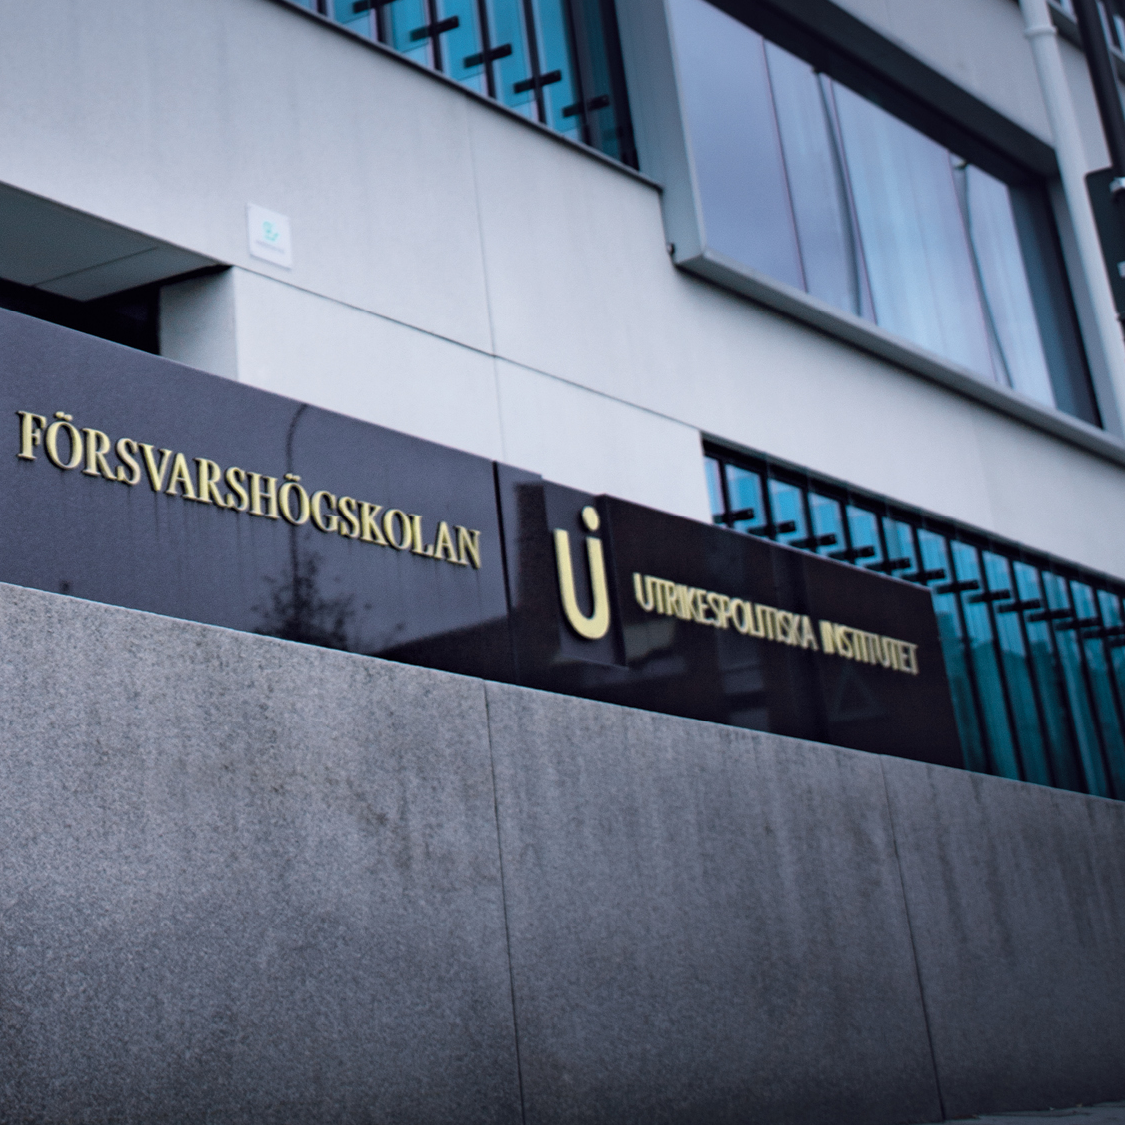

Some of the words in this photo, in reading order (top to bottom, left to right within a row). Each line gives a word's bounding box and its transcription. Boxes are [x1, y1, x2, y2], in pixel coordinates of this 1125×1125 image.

[17, 410, 481, 569] FÖRSVARSHÖGSKOLAN
[633, 572, 819, 651] UTRIKESPOLITISKA
[818, 620, 919, 675] INSTITUTET
